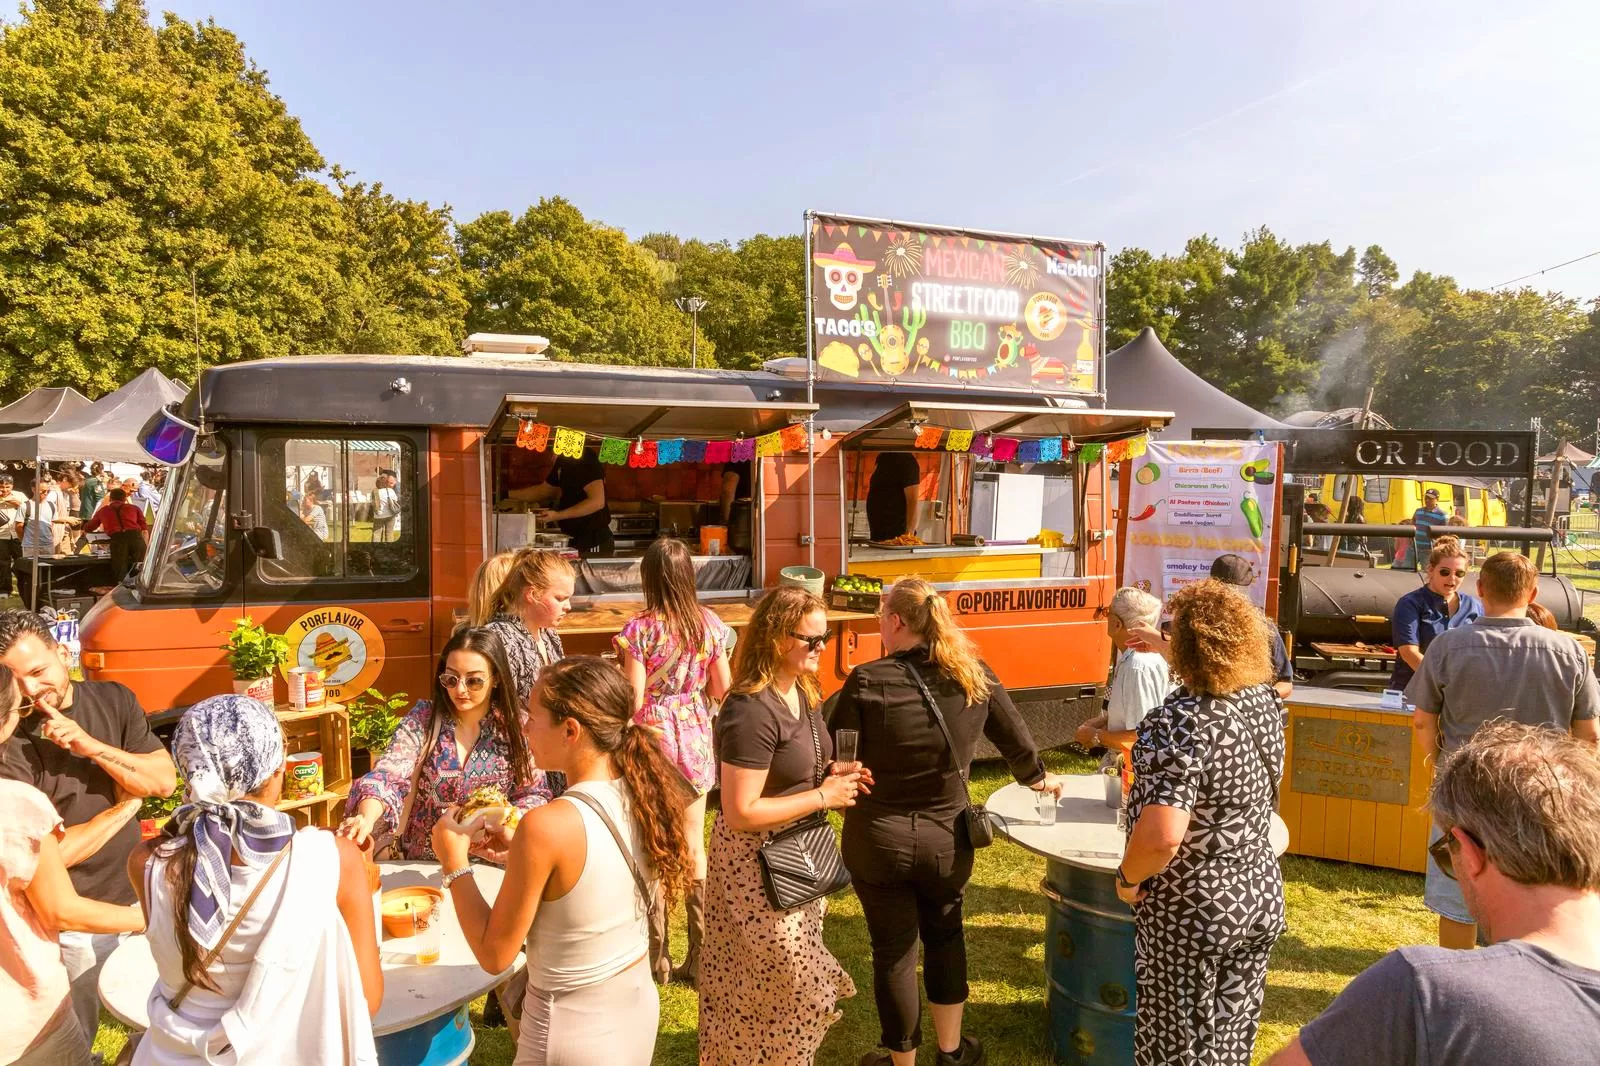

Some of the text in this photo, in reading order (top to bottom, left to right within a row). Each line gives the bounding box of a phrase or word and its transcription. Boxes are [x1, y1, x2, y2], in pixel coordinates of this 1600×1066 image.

[925, 248, 1006, 282] MEXICAN
[1046, 255, 1098, 277] Nacho
[911, 282, 1019, 318] STREETFOOD
[815, 317, 877, 337] TACO'S
[950, 320, 987, 350] BBQ
[1415, 441, 1520, 466] FOOD
[956, 588, 1087, 615] @PORFLAVORFOOD
[299, 611, 365, 632] PORFLAVOR
